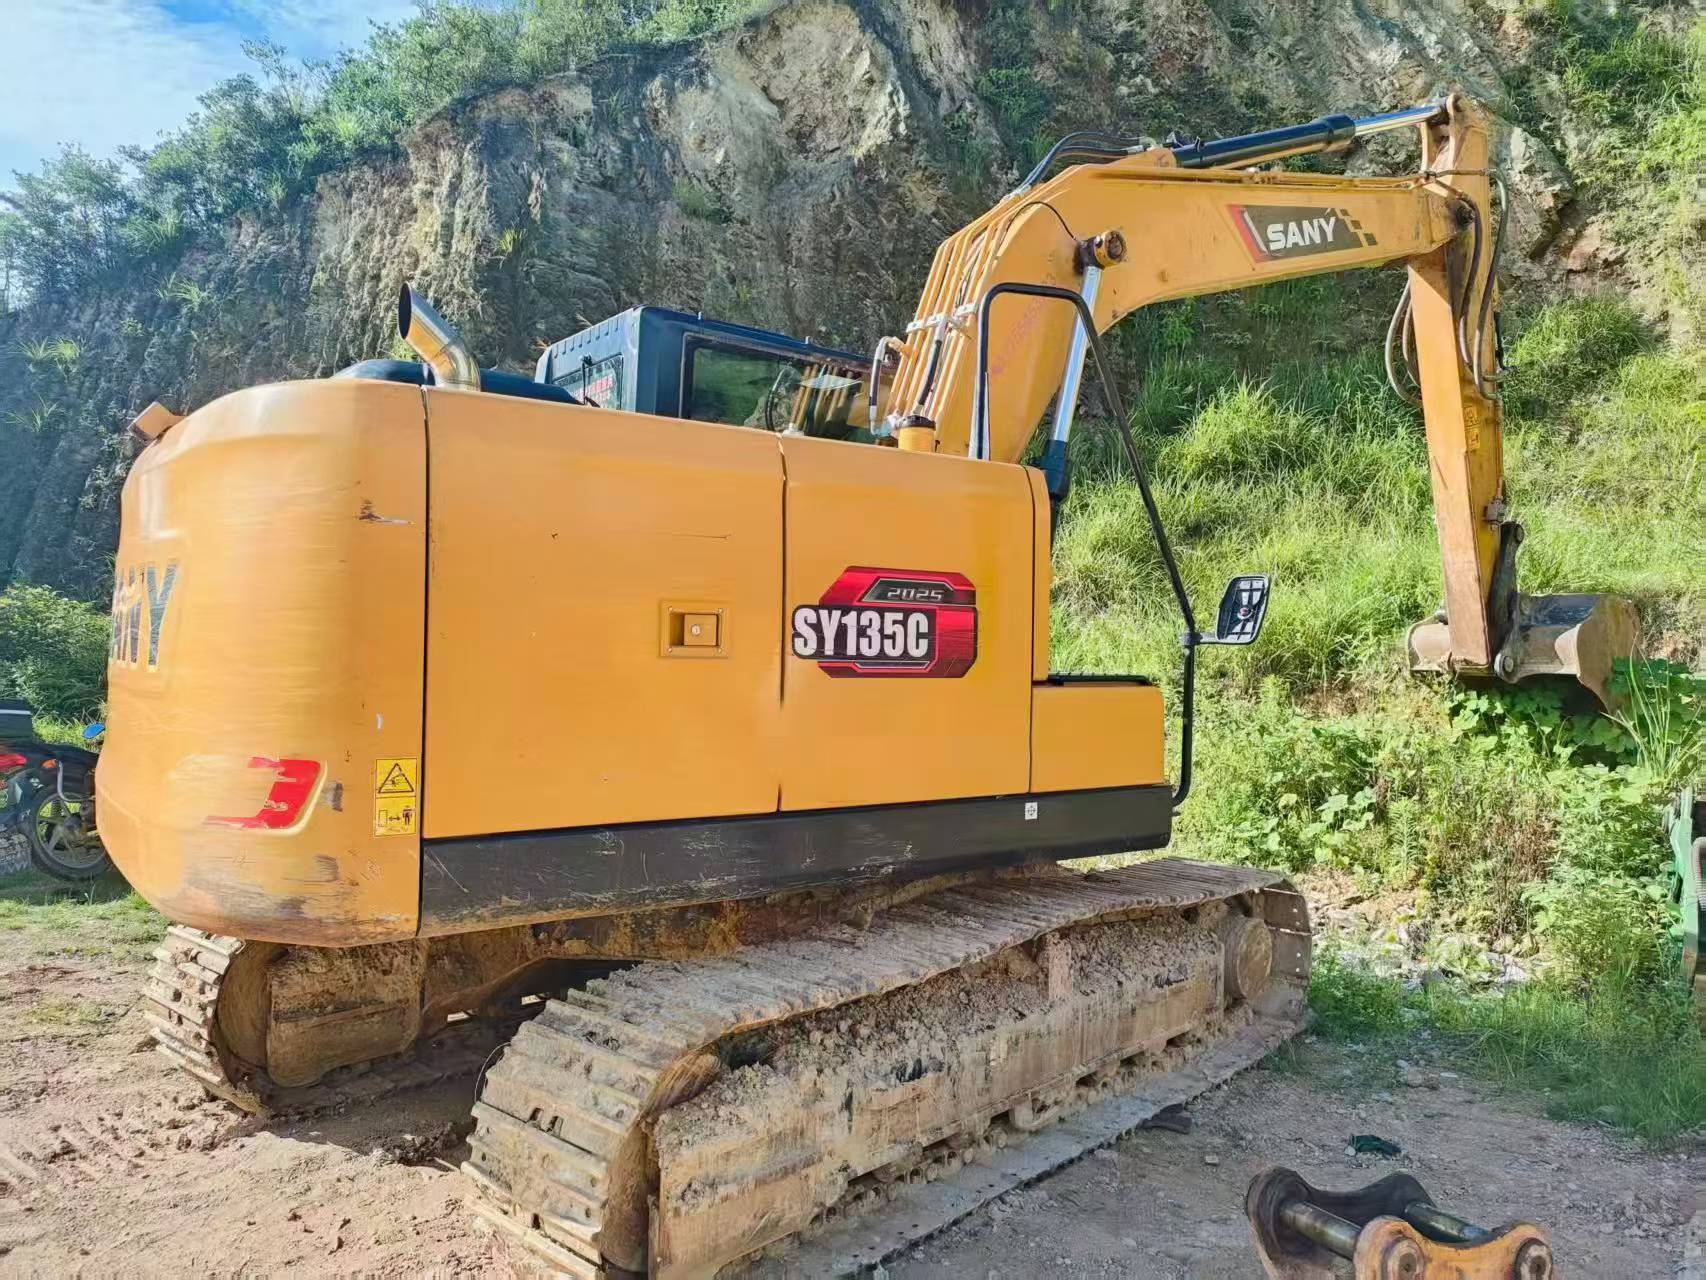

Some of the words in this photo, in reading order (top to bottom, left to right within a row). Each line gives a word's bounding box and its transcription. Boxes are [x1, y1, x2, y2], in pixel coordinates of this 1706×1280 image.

[1267, 217, 1336, 250] SANY
[887, 587, 944, 602] 2025
[794, 608, 929, 657] SY135C
